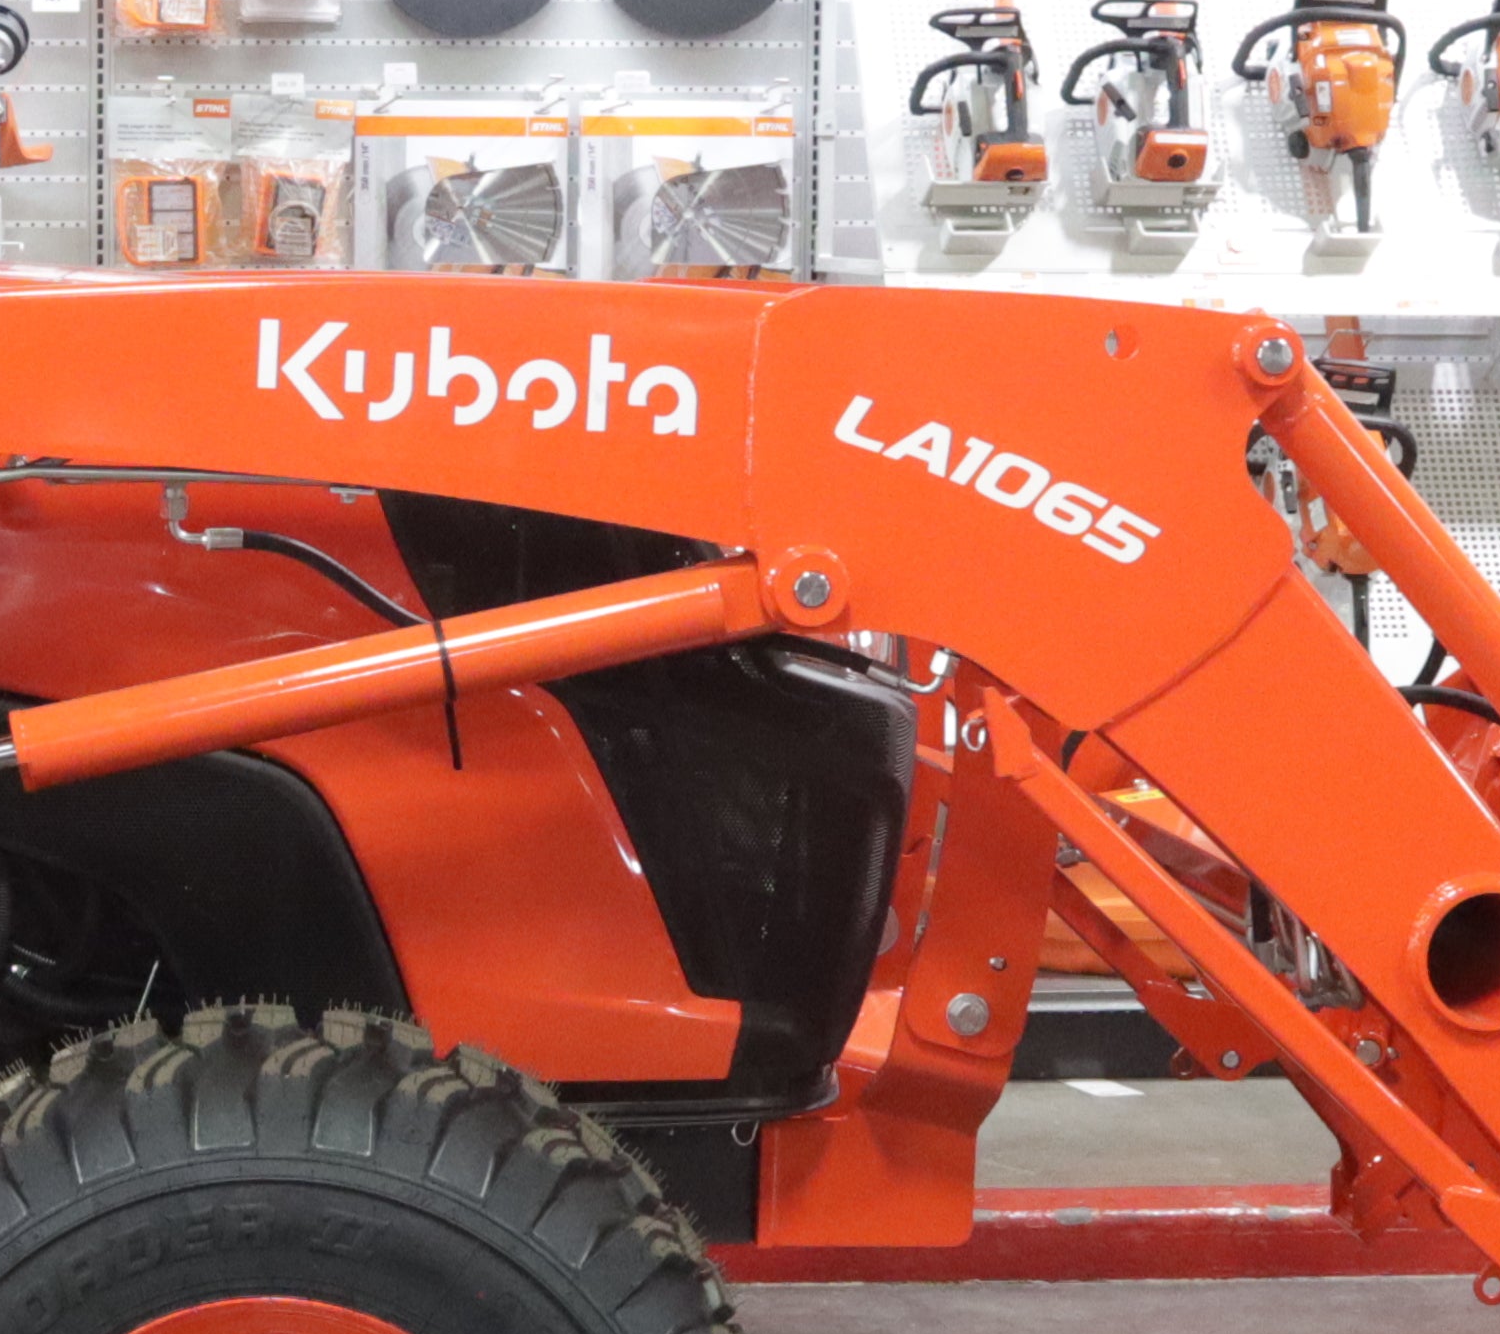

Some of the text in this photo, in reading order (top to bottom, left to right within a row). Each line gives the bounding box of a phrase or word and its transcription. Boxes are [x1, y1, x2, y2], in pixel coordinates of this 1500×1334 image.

[195, 103, 229, 114] STIHL
[317, 105, 351, 116] STIHL
[531, 122, 565, 132] STIHL
[756, 122, 789, 132] STIHL
[256, 317, 699, 438] Kubota
[833, 395, 1160, 565] LA1065
